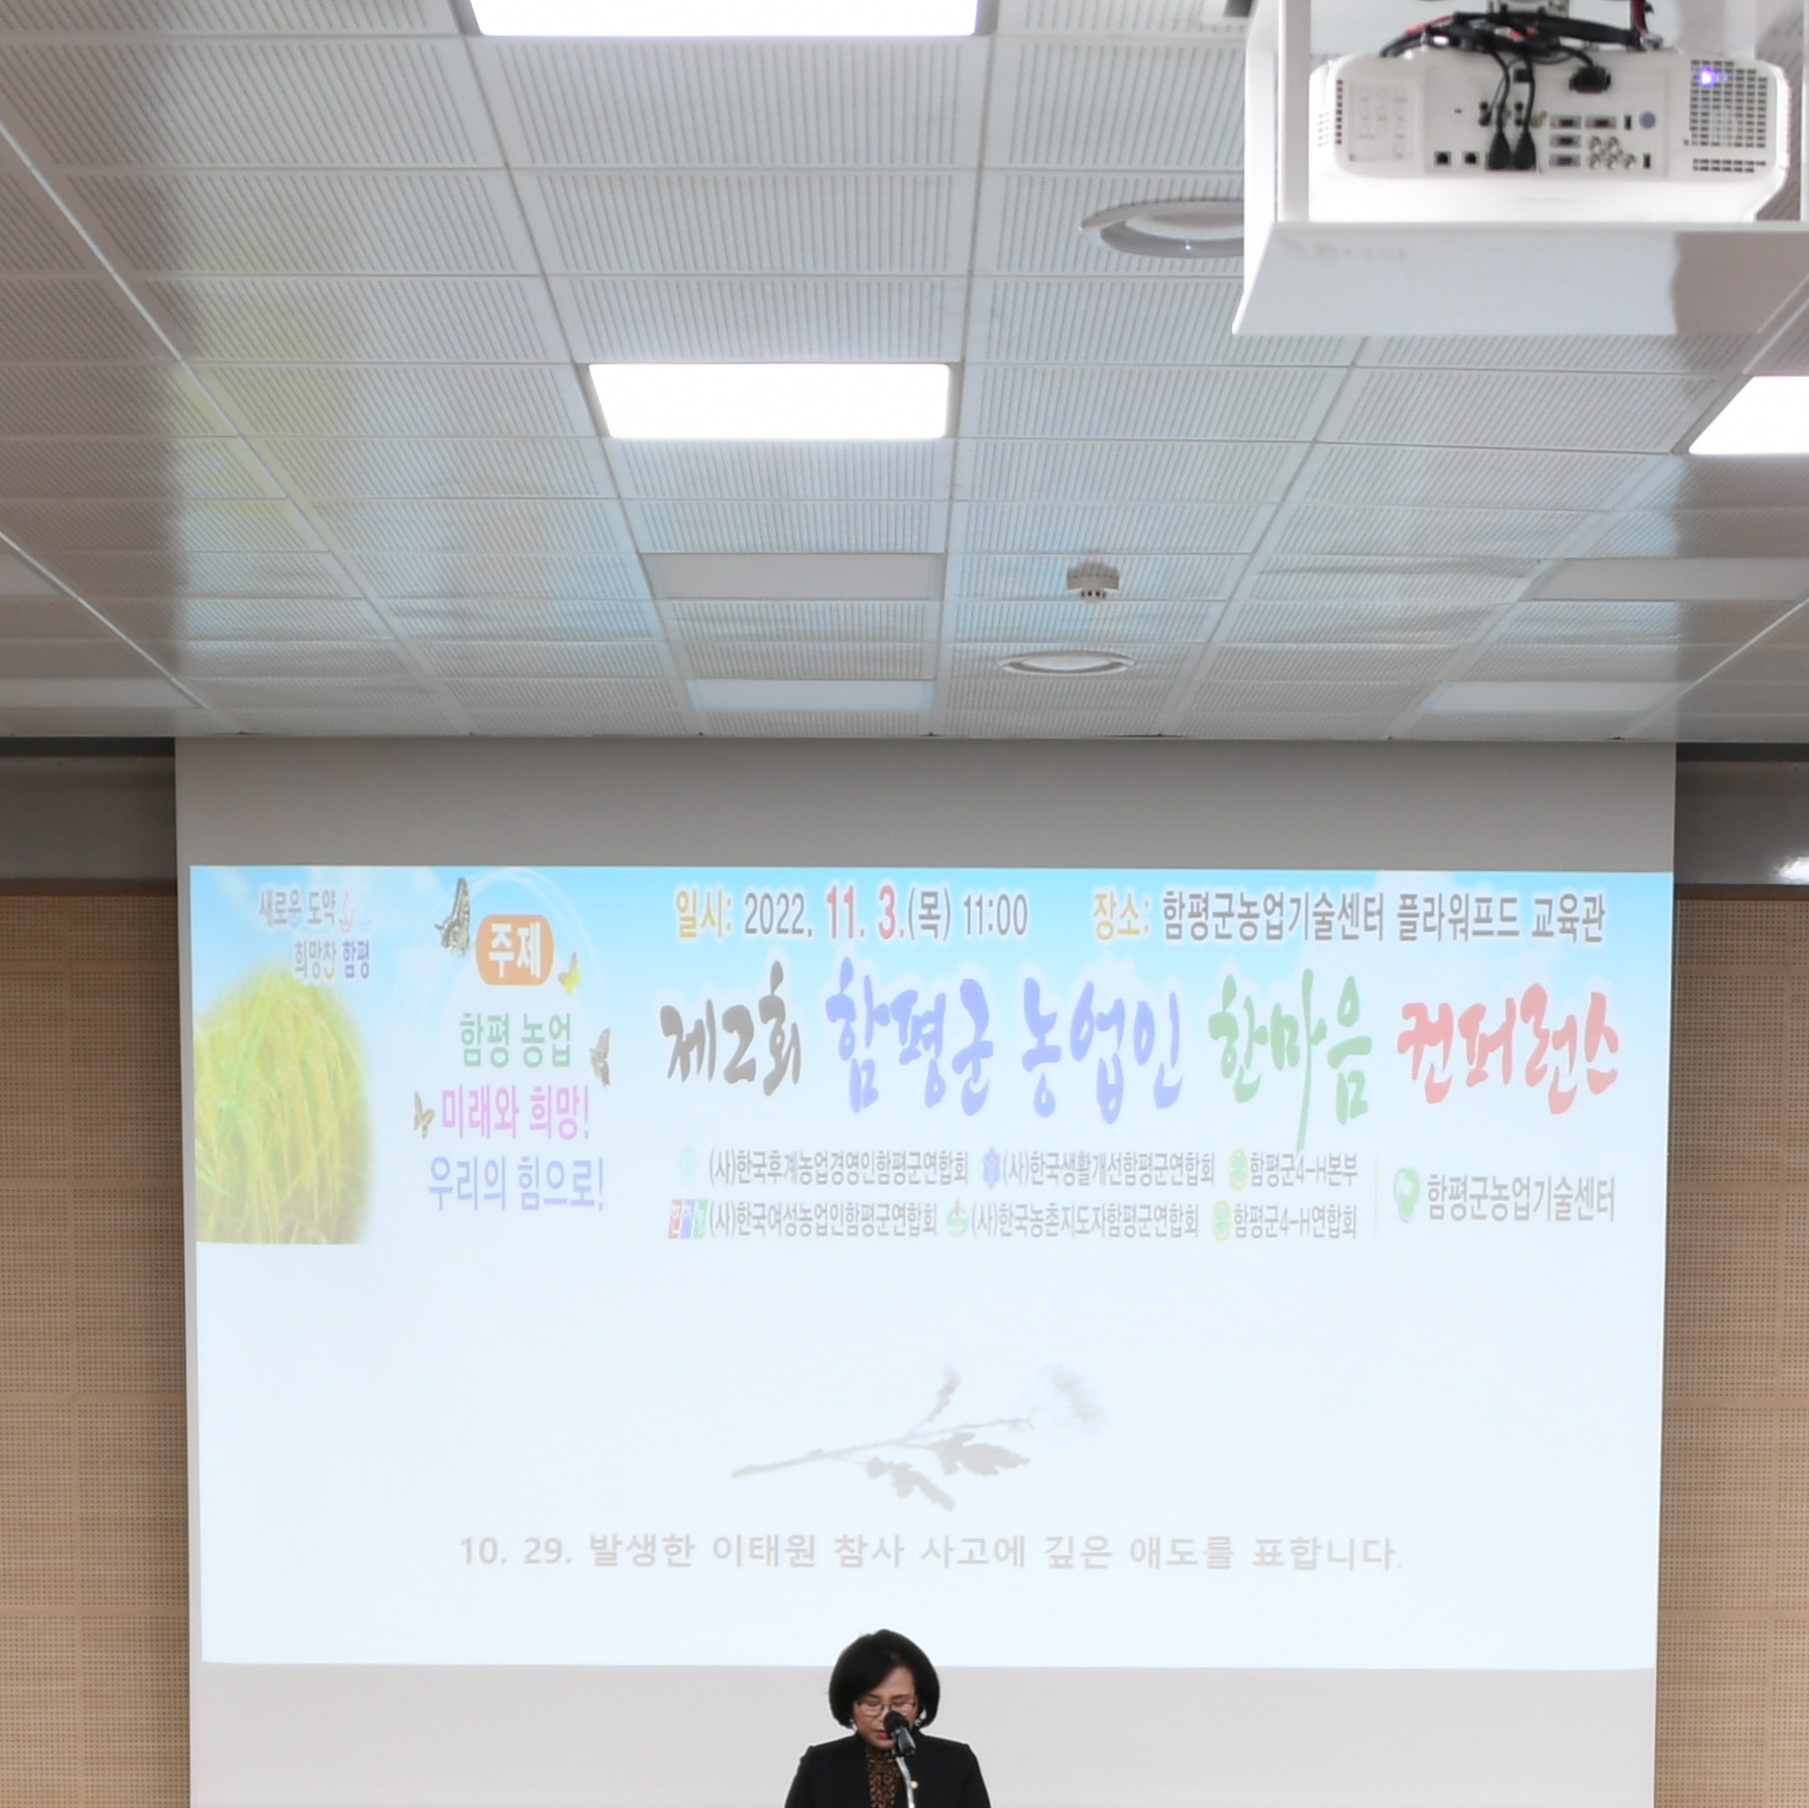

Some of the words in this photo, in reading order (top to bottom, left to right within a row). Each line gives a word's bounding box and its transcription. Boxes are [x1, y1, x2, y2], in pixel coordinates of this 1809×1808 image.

[259, 889, 301, 928] 새로운
[307, 889, 336, 926] 도약
[675, 888, 732, 938] 일시:
[826, 885, 865, 939] 11.
[963, 894, 1028, 937] 11:00
[1094, 891, 1149, 941] 장소:
[1163, 891, 1384, 941] 함평군농업기술센터
[1397, 892, 1520, 941] 플라워프드
[1531, 893, 1605, 943] 교육관
[295, 940, 336, 980] 희망찬
[342, 940, 370, 980] 함평
[488, 921, 541, 978] 주제
[459, 1012, 509, 1068] 함평
[521, 1012, 571, 1068] 농업
[660, 959, 801, 1097] 제2회
[826, 956, 994, 1116] 함평군
[1022, 977, 1183, 1125] 농업인
[1208, 968, 1372, 1155] 한마음
[1397, 983, 1619, 1115] 컨퍼런스
[441, 1084, 519, 1139] 미래와
[530, 1084, 589, 1141] 희망!
[428, 1156, 506, 1211] 우리의
[518, 1156, 603, 1211] 힘으로!
[1427, 1174, 1616, 1222] 함평군농업기술센터
[459, 1536, 508, 1565] 10.
[523, 1536, 573, 1565] 29.
[589, 1532, 696, 1568] 발생한
[712, 1533, 817, 1569] 이태원
[833, 1533, 905, 1569] 참사
[920, 1534, 1026, 1569] 사고에
[1045, 1535, 1113, 1570] 깊은
[1129, 1535, 1235, 1570] 애도를
[1251, 1535, 1404, 1571] 표합니다.
